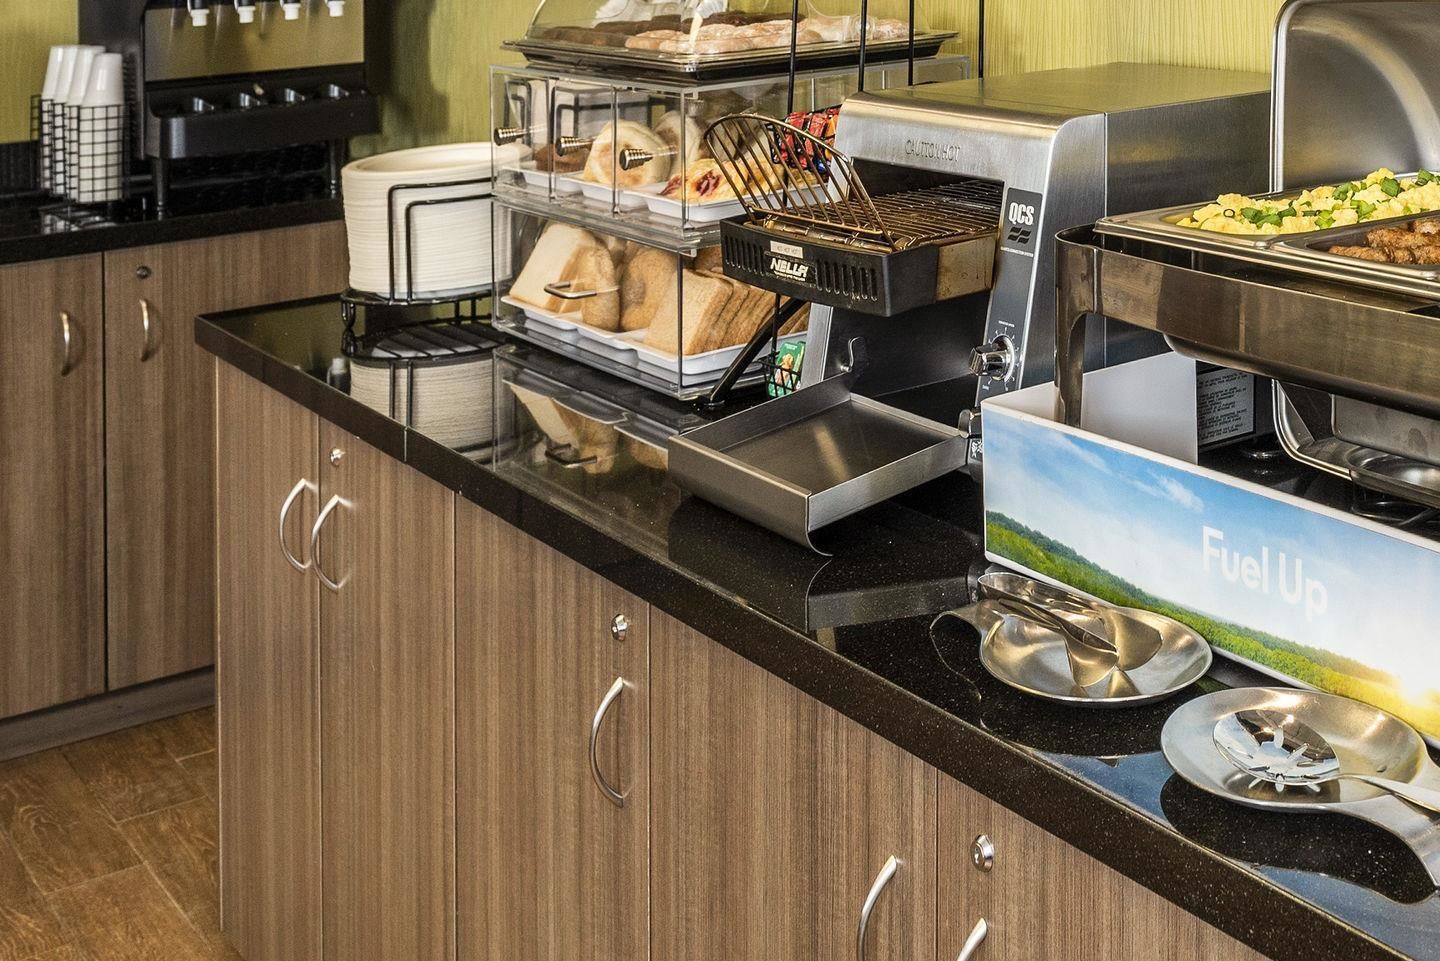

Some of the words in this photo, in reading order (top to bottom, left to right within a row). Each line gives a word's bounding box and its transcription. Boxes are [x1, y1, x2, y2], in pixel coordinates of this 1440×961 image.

[1008, 202, 1035, 225] QCS
[1202, 525, 1269, 593] Fuel
[1278, 551, 1328, 622] Up
